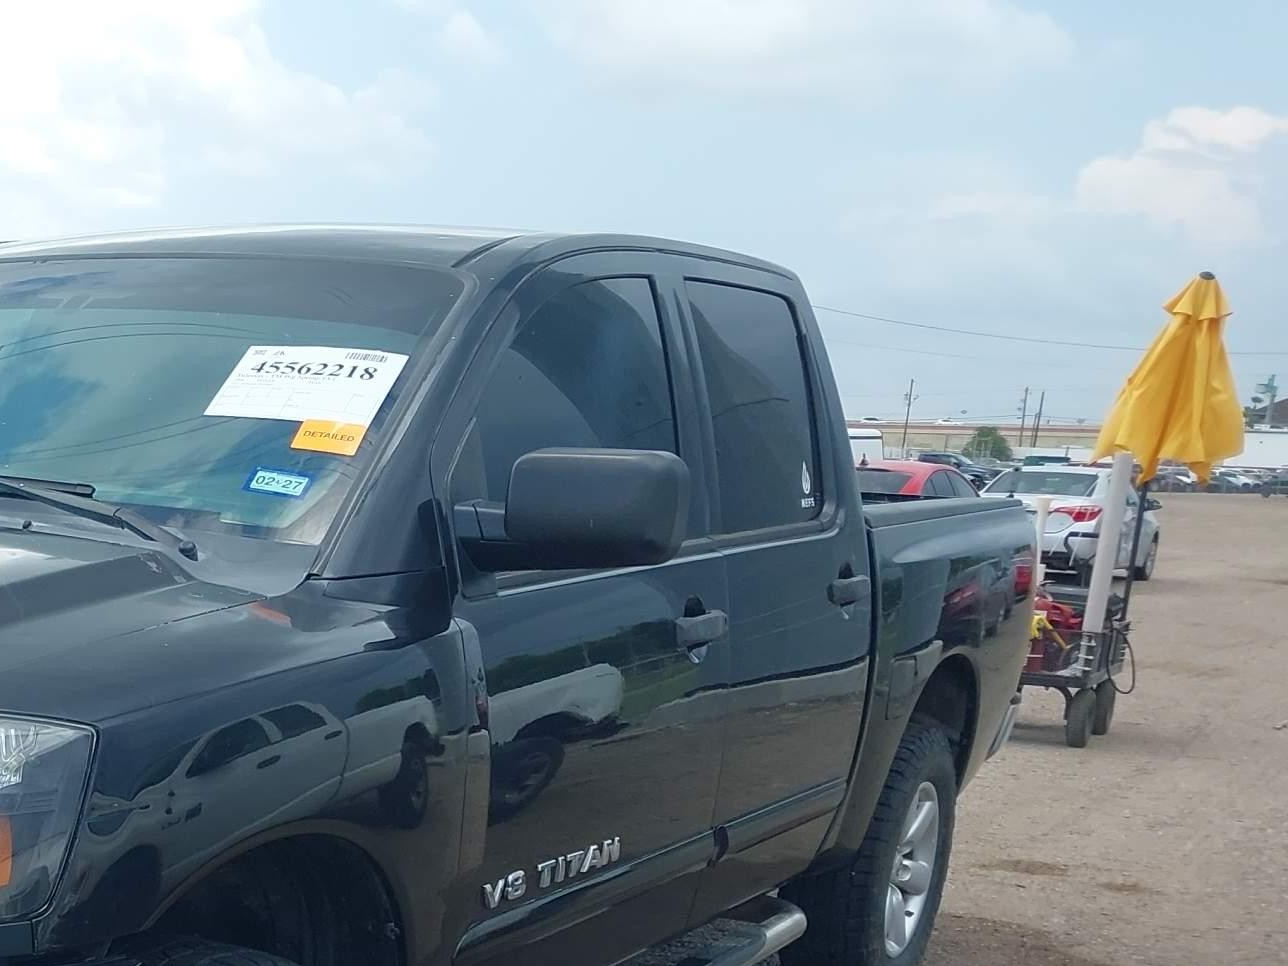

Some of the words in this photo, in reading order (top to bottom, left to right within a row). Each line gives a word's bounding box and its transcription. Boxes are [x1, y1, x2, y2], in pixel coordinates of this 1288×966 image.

[251, 361, 378, 381] 45562218
[303, 430, 355, 442] DETAILED
[482, 870, 527, 909] V8
[537, 836, 621, 888] TITAN
